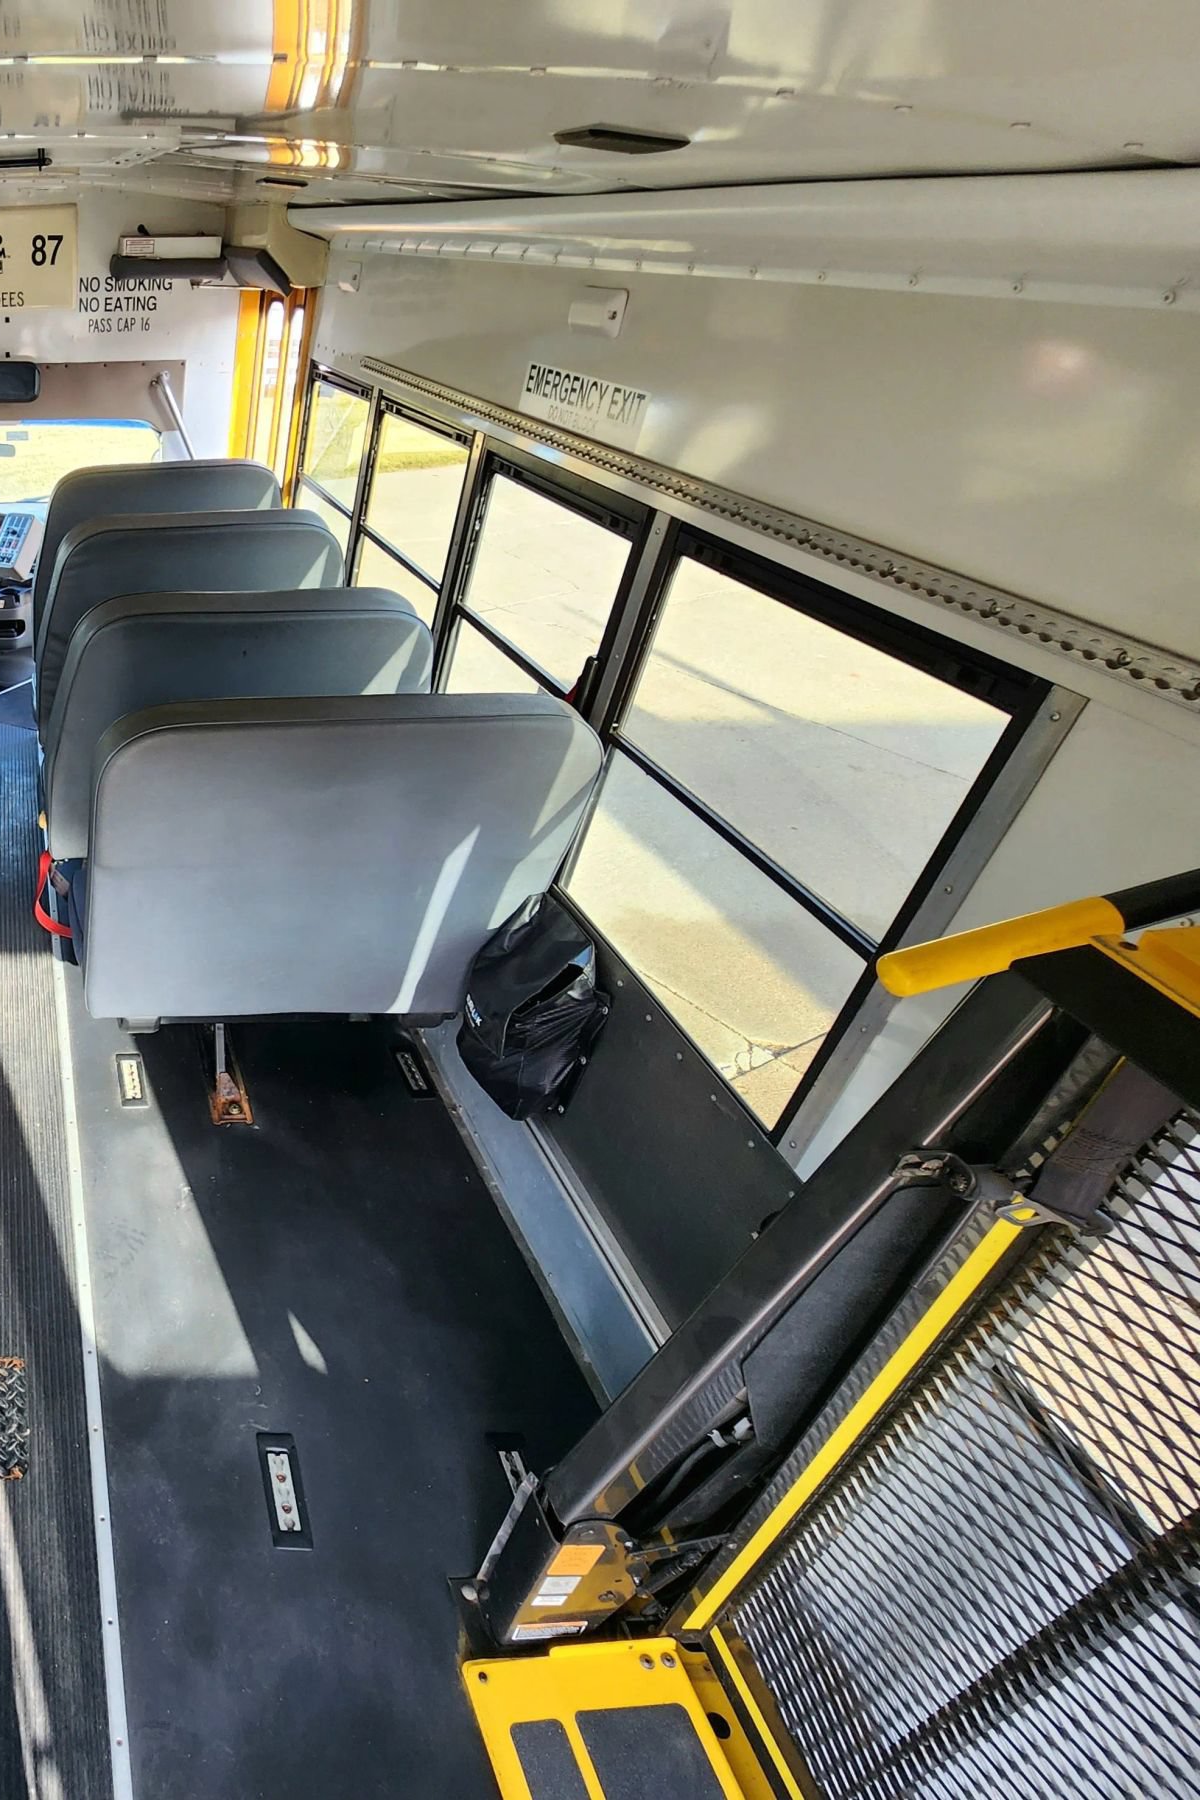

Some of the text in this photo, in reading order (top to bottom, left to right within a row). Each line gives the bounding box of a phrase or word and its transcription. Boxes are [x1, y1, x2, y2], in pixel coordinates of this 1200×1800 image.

[31, 234, 63, 266] 87
[79, 276, 173, 292] NO SMOKING
[79, 296, 157, 312] NO EATING
[88, 316, 150, 333] PASS CAP 16
[526, 364, 647, 425] EMERGENCY EXIT
